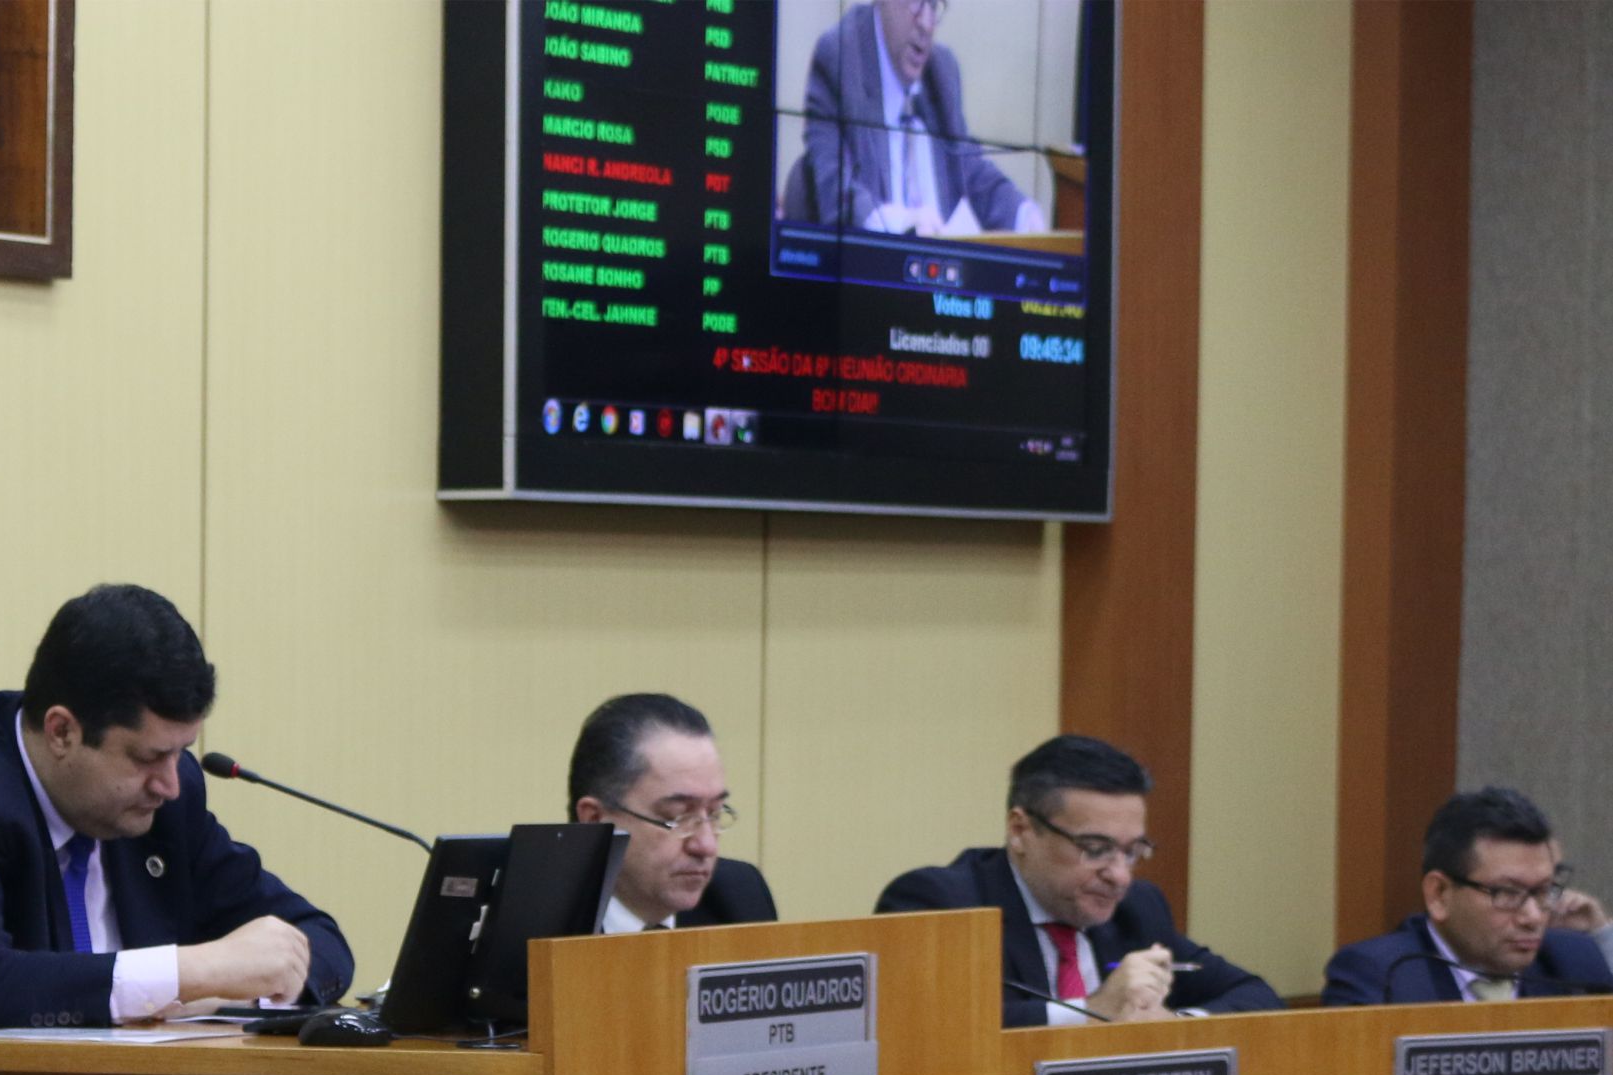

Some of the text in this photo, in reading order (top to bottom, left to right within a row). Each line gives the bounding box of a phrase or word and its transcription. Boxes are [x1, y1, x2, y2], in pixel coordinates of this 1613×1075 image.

[581, 6, 644, 34] MIRANDA
[580, 42, 633, 68] SABINO
[705, 61, 759, 87] PATRIOT
[706, 102, 741, 125] PODE
[543, 114, 596, 140] MARCIO
[597, 121, 635, 145] ROSA
[543, 152, 584, 175] NANCI
[603, 160, 673, 186] ANDREOLA
[543, 189, 731, 230] PROTETOR JORGE PTB
[602, 233, 666, 258] QUADROS
[704, 243, 731, 265] PTB
[933, 293, 972, 317] Votos
[703, 312, 737, 333] PODE
[890, 326, 970, 356] Licenciados
[791, 353, 812, 377] DA
[700, 976, 863, 1016] ROGÉRIO QUADROS
[769, 1023, 795, 1045] PTB
[1510, 1047, 1601, 1073] BRAYNER
